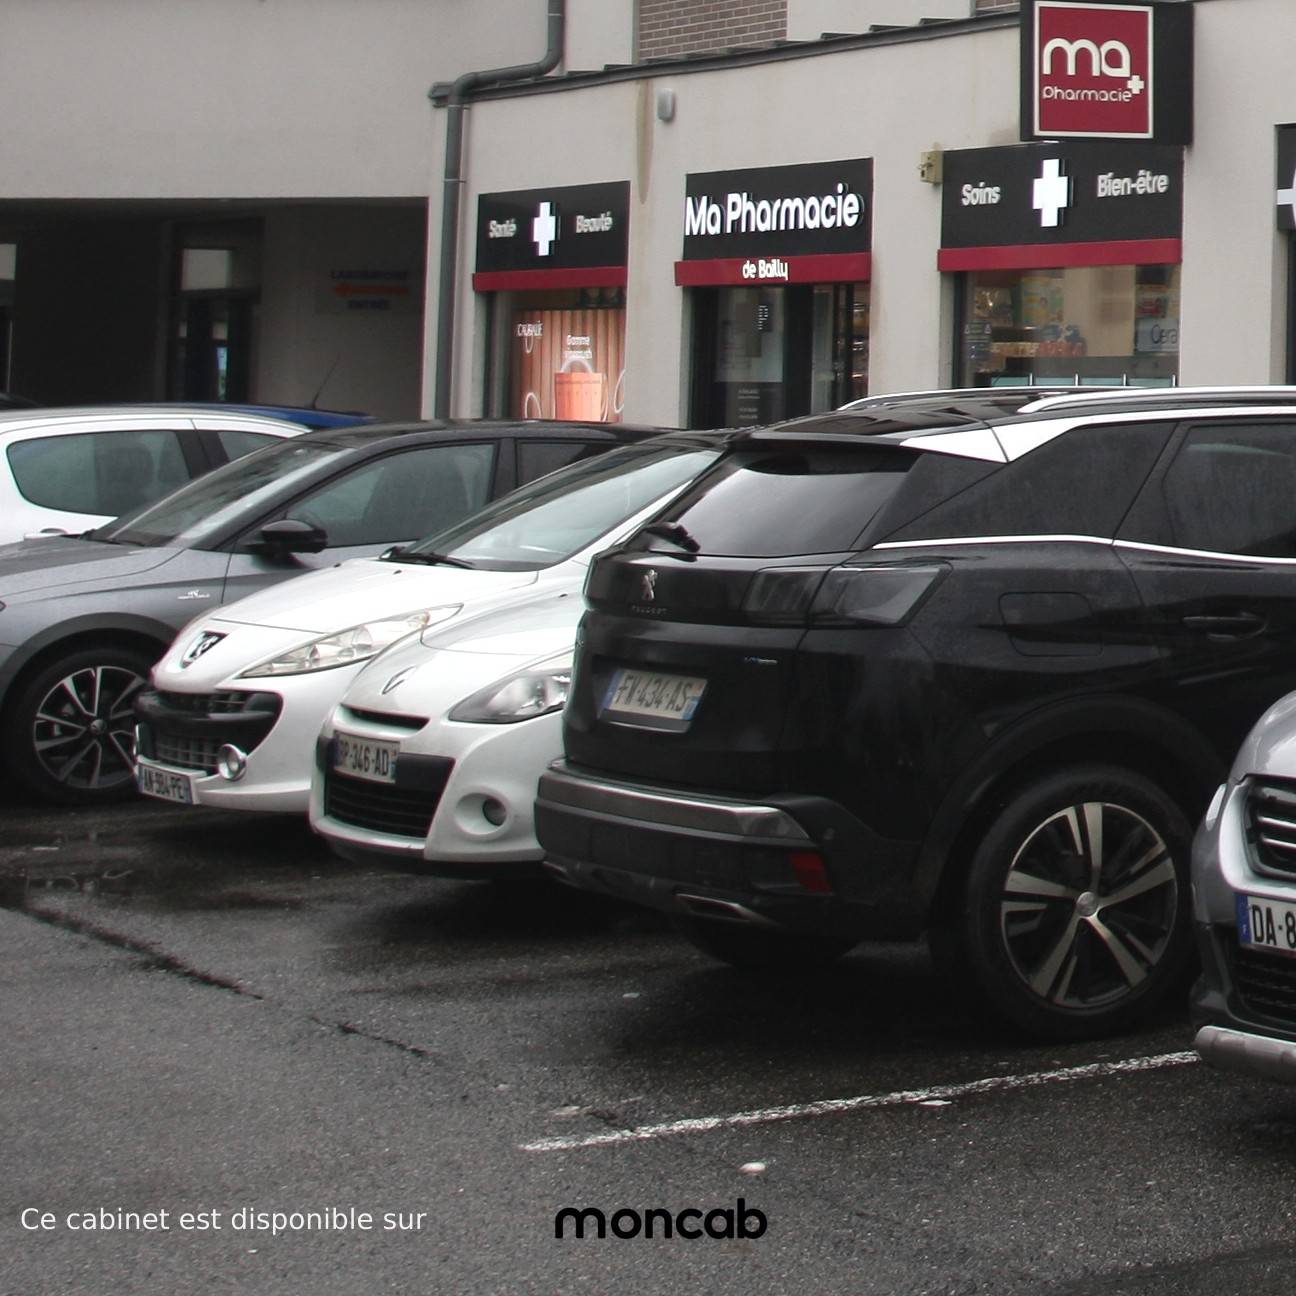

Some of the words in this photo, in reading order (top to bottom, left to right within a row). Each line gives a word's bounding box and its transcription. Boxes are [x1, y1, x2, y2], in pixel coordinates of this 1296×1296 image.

[1043, 38, 1130, 77] ma
[962, 181, 1001, 206] Soins
[1097, 170, 1170, 197] Bien-être
[576, 210, 613, 234] Beauté
[684, 196, 721, 236] Ma
[726, 183, 860, 234] Pharmacie
[489, 218, 517, 238] Santé
[742, 260, 757, 279] de
[758, 259, 789, 281] Bailly
